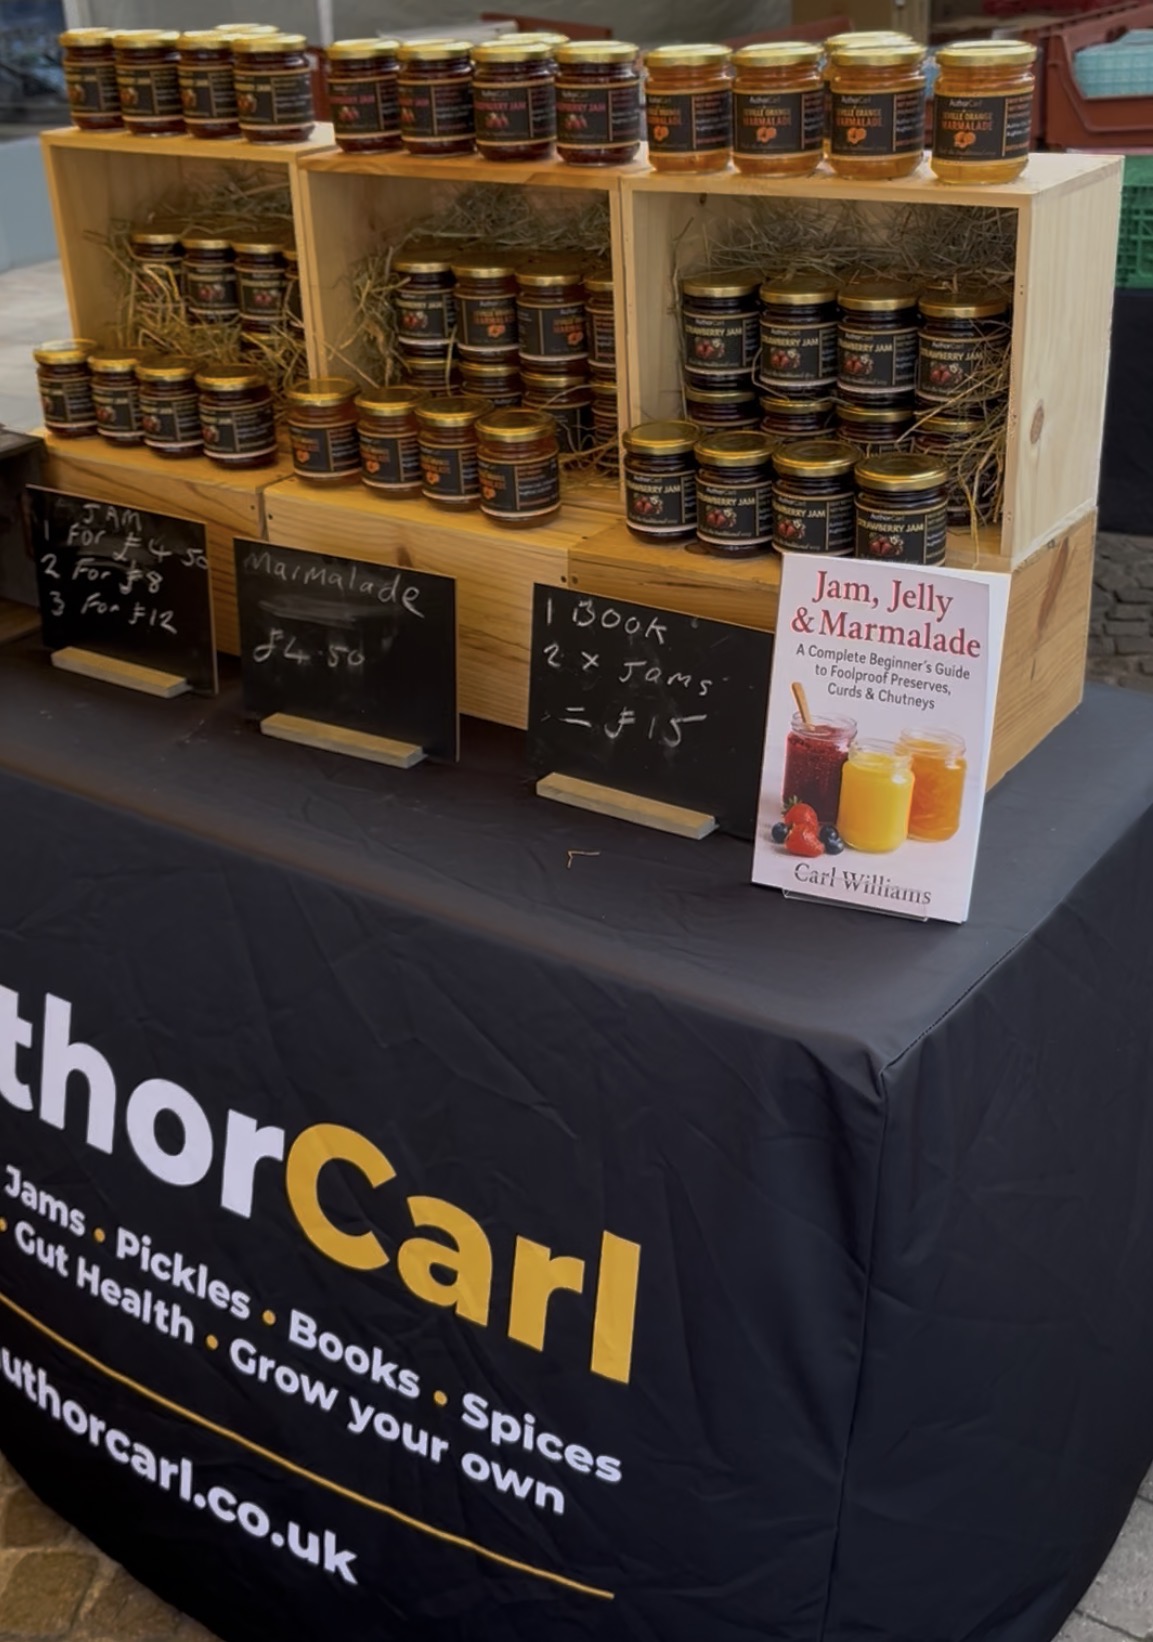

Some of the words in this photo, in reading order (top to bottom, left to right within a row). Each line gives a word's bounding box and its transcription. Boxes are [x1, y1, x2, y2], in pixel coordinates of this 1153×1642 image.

[43, 519, 50, 541] 1
[82, 503, 142, 532] JAM
[807, 509, 826, 518] JAM
[905, 523, 924, 533] JAM
[40, 553, 61, 579] 2
[118, 559, 163, 595] £8
[244, 551, 425, 620] Marmalade
[49, 590, 65, 617] 3
[128, 601, 178, 635] £12
[546, 597, 553, 626] 1
[812, 570, 879, 609] Jam,
[887, 580, 953, 622] Jelly
[790, 607, 815, 634] &
[819, 609, 981, 658] Marmalade
[543, 643, 561, 668] 2
[796, 644, 806, 656] A
[808, 644, 867, 664] Complete
[869, 653, 932, 674] Beginner's
[935, 662, 971, 680] Guide
[815, 664, 828, 676] to
[830, 665, 889, 683] Foolproof
[891, 674, 951, 696] Preserves,
[828, 682, 863, 699] Curds
[865, 688, 876, 700] &
[878, 690, 936, 711] Chutneys
[604, 706, 708, 747] £15
[794, 862, 837, 888] Carl
[842, 870, 932, 905] Williams
[5, 1165, 86, 1236] Jams
[116, 1227, 251, 1320] Pickles
[288, 1308, 421, 1399] Books
[461, 1392, 623, 1482] Spices
[14, 1221, 69, 1277] Gut
[76, 1256, 194, 1345] Health
[229, 1338, 339, 1411] Grow
[347, 1396, 450, 1463] your
[461, 1452, 566, 1515] own
